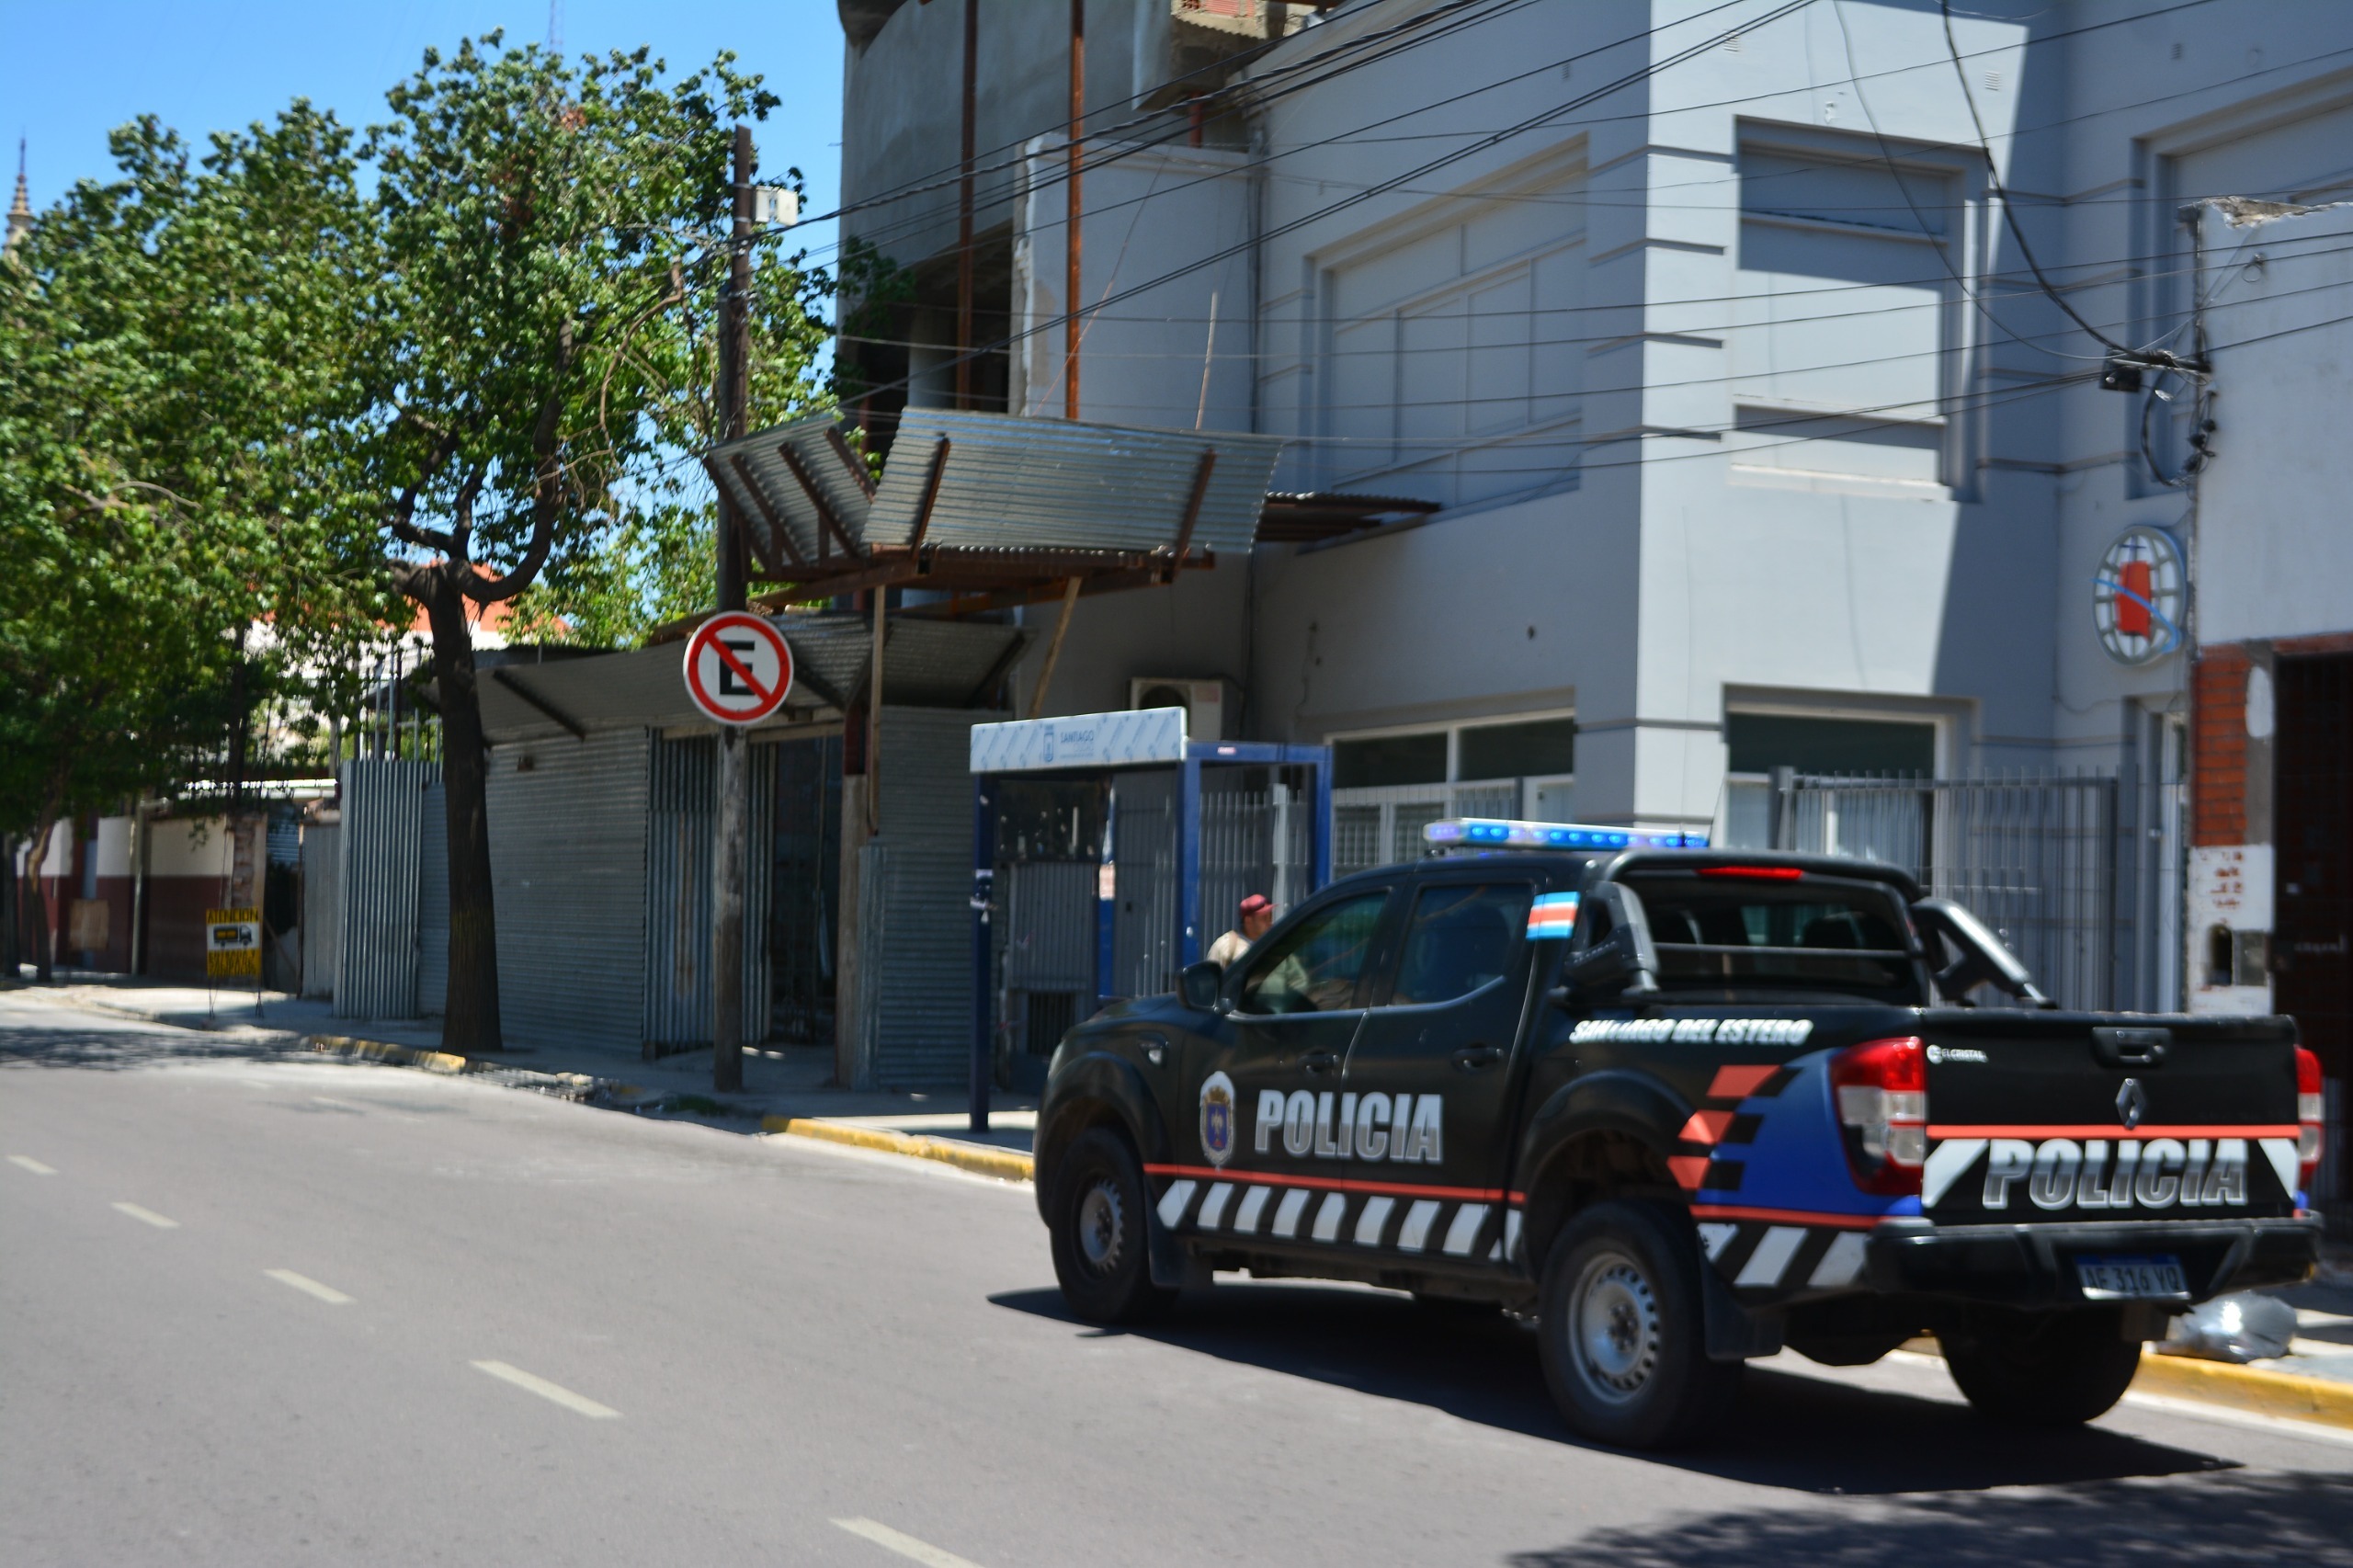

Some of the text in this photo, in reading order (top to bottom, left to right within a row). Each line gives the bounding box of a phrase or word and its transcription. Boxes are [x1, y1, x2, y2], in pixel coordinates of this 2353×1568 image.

[720, 641, 756, 695] E
[1060, 730, 1095, 744] SANTIAGO
[1569, 1018, 1813, 1045] SANTIAGO DEL ESTERO
[1255, 1089, 1443, 1163] POLICIA
[1982, 1138, 2249, 1210] POLICIA
